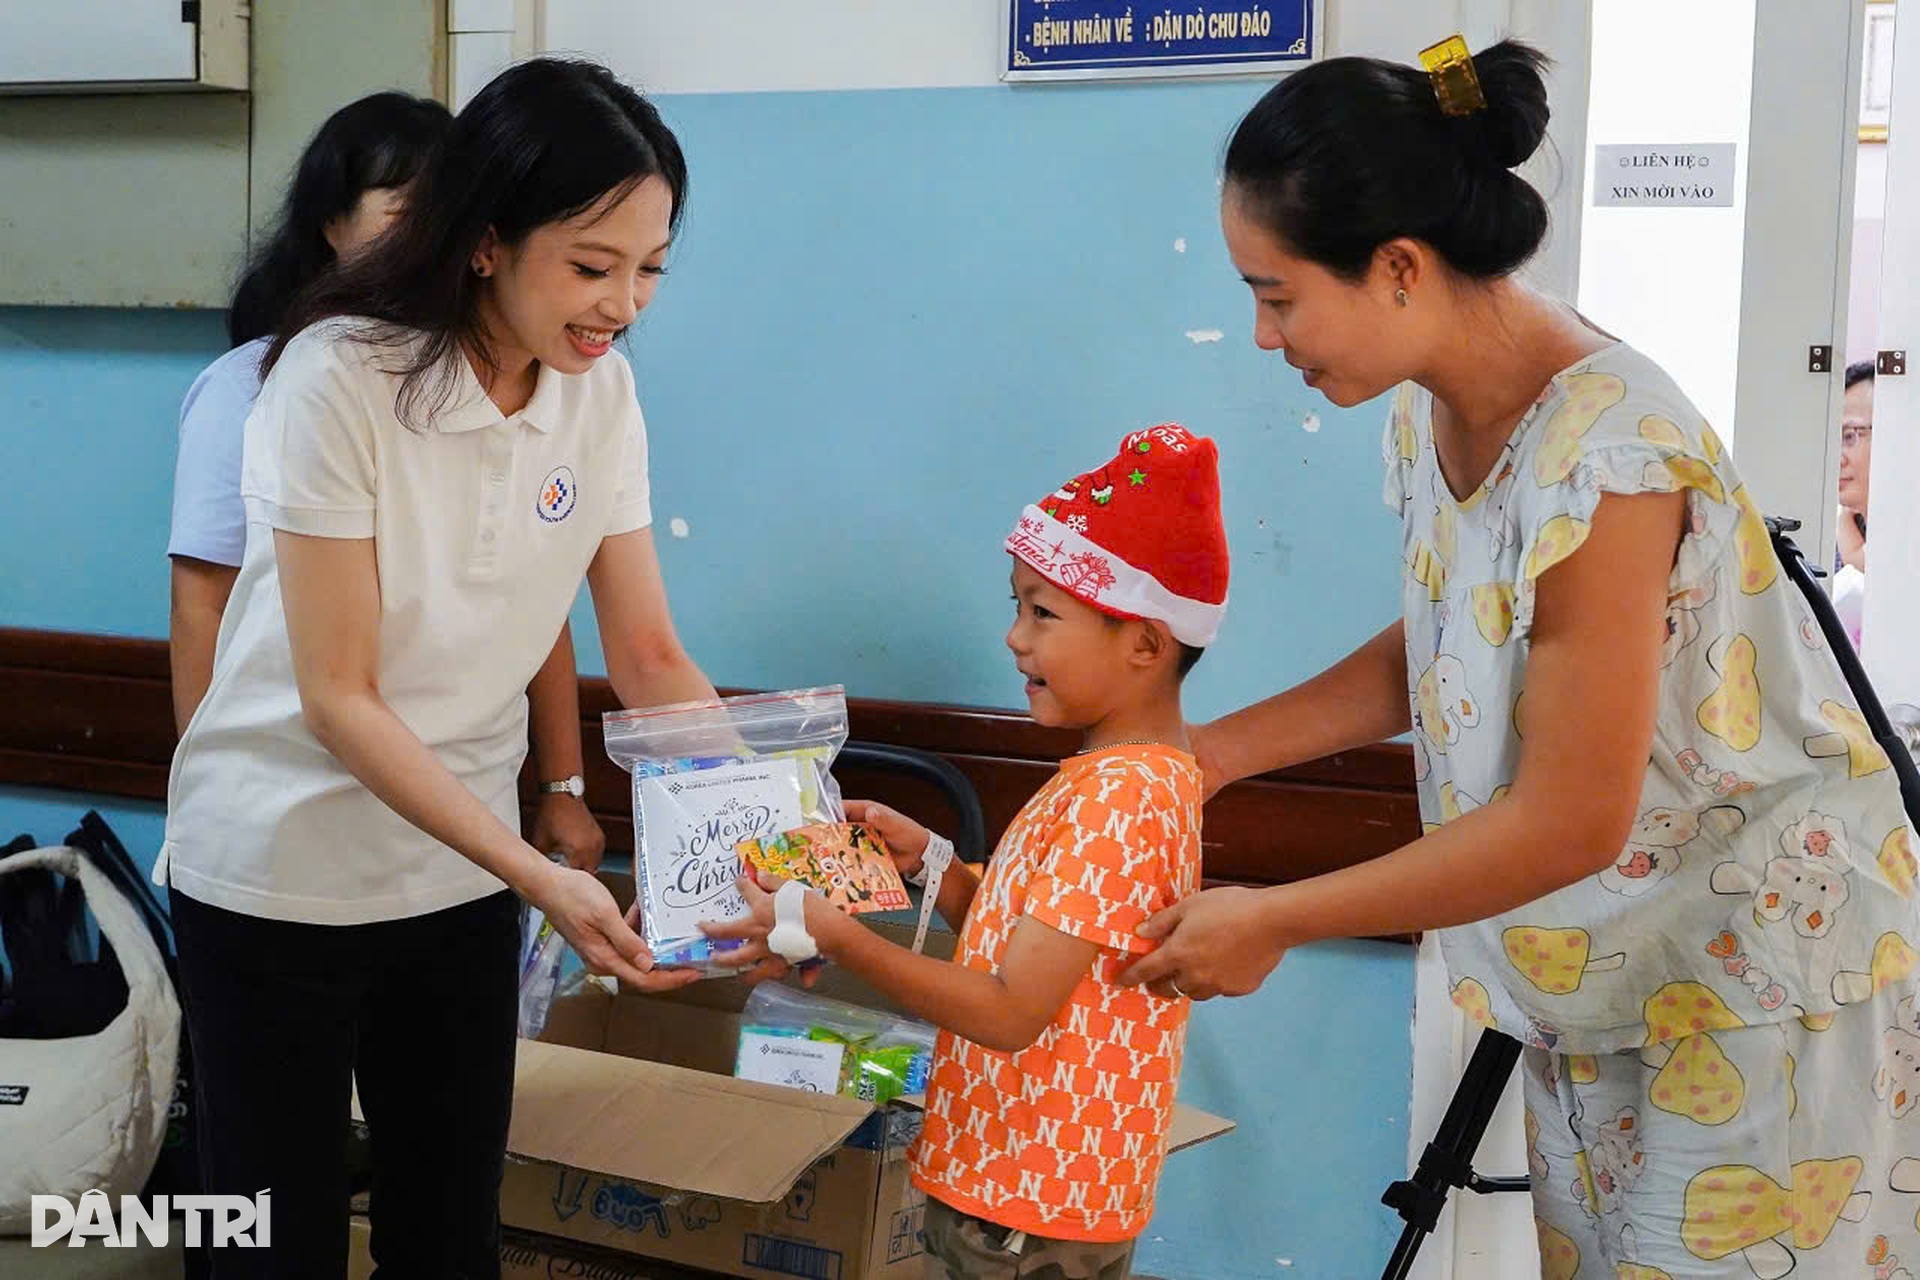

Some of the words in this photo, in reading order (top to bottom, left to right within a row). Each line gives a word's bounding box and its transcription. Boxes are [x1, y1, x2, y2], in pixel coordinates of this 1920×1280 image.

[1033, 16, 1067, 53] BỆNH
[1073, 12, 1112, 45] NHÂN
[1115, 7, 1133, 43] VỀ
[1186, 7, 1205, 40] DÒ
[1208, 13, 1238, 39] CHU
[1241, 4, 1271, 37] ĐÁO
[1632, 152, 1669, 167] LIÊN
[1611, 186, 1639, 199] XIN
[1643, 183, 1675, 199] MỜI
[690, 805, 770, 856] Merry
